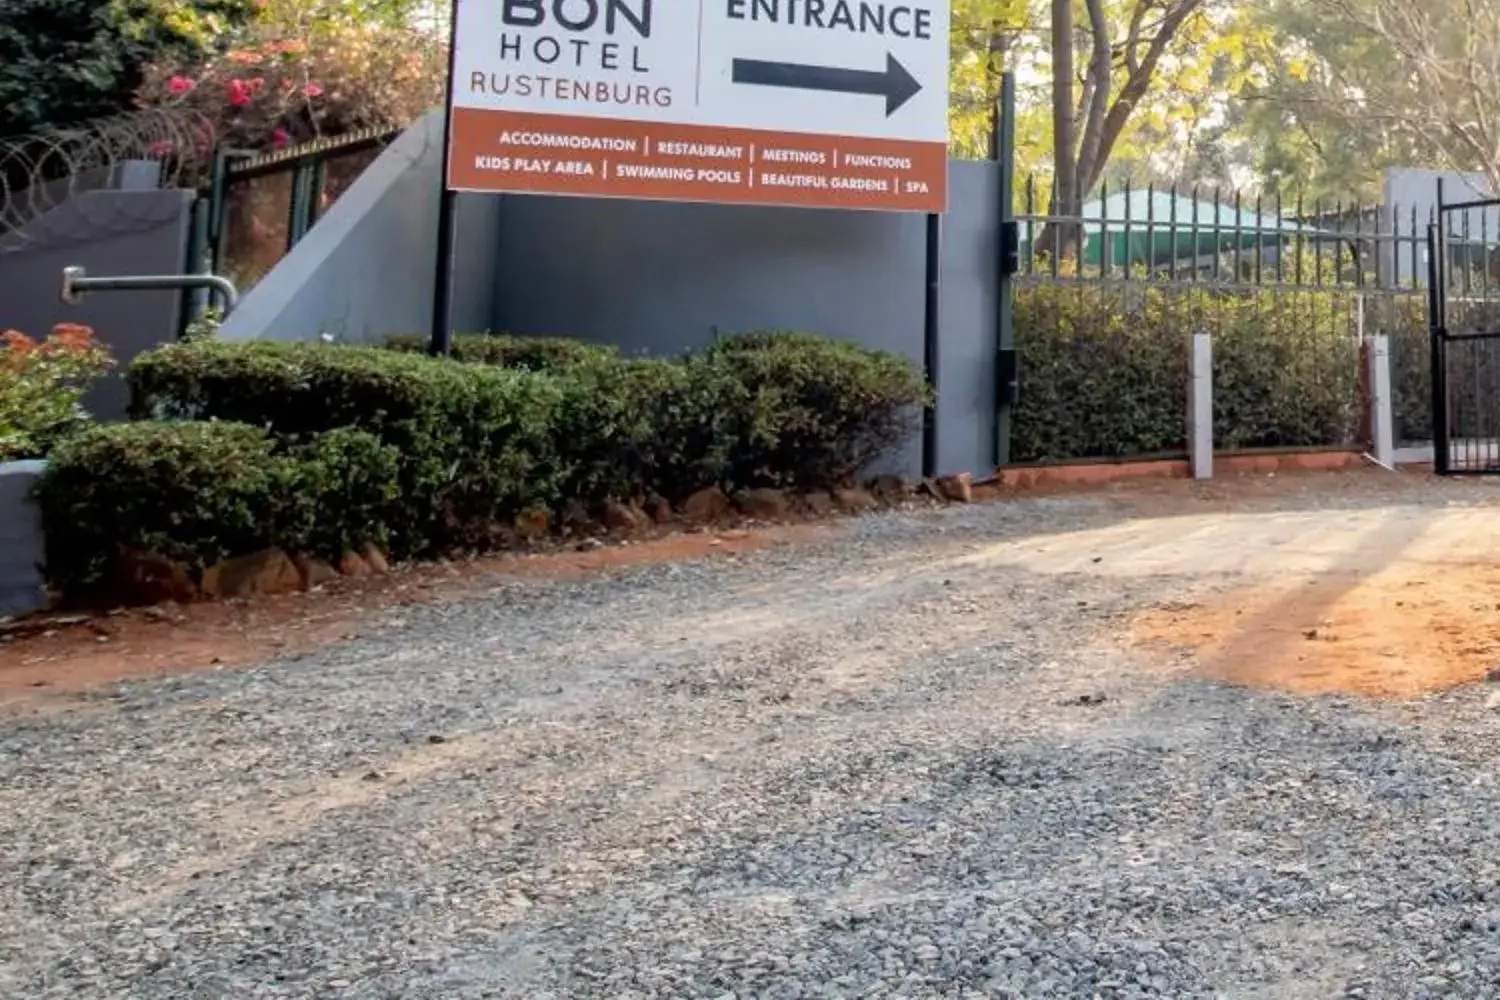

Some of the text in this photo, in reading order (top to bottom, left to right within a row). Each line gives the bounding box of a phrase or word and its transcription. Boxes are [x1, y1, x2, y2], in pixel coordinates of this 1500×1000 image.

[500, 32, 649, 73] HOTEL
[470, 71, 672, 107] RUSTENBURG
[499, 131, 912, 169] ACCOMMODATION RESTAURANT MEETINGS FUNCTIONS
[475, 155, 929, 193] KIDS PLAY AREA SWIMMING POOLS BEAUTIFUL GARDENS SPA
